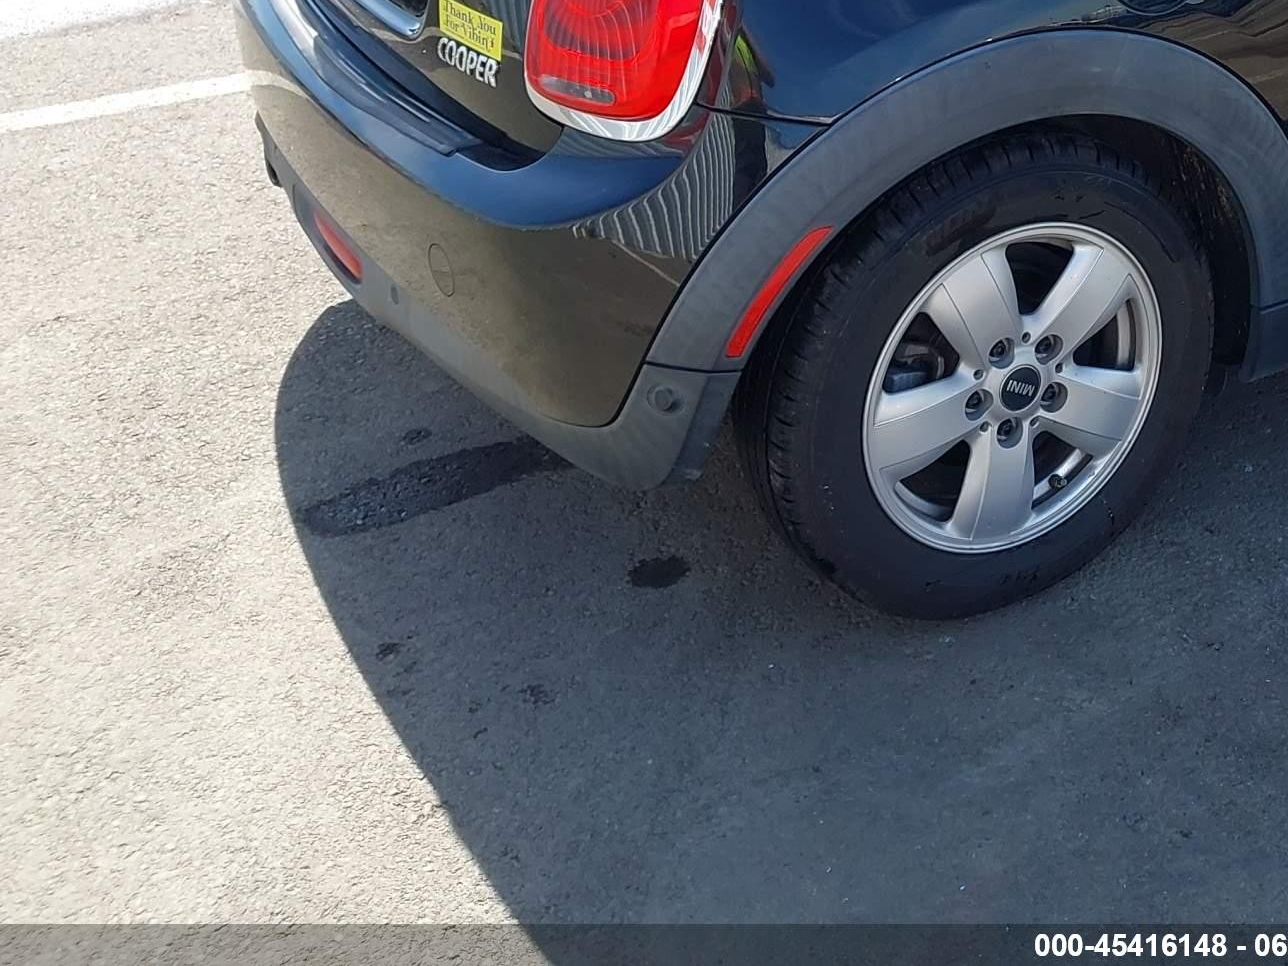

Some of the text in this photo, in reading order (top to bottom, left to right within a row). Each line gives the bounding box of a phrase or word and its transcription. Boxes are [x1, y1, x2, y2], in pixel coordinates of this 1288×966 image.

[445, 14, 460, 32] For
[477, 15, 496, 36] You
[437, 37, 497, 88] COOPER
[1006, 379, 1035, 396] MINI
